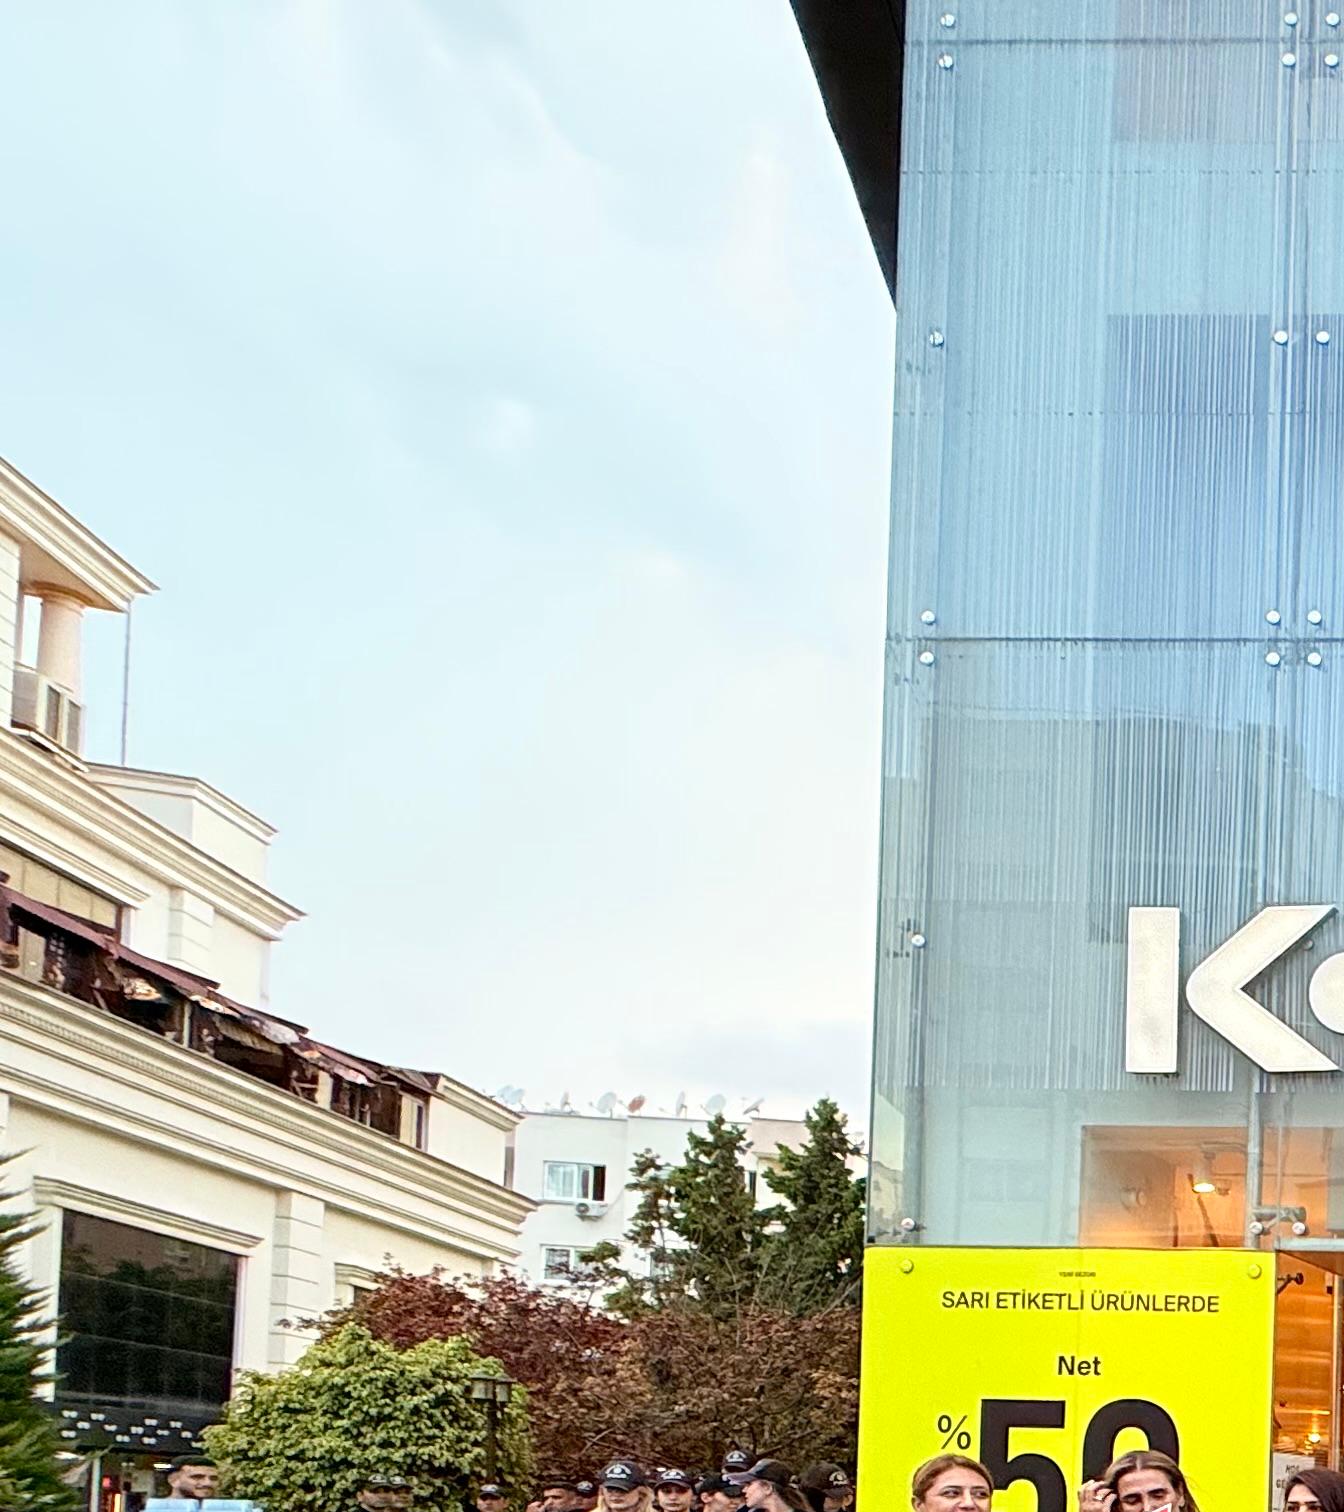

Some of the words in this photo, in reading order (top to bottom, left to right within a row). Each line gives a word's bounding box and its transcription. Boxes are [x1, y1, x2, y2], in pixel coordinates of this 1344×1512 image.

[942, 1291, 989, 1310] SARI
[996, 1289, 1084, 1311] ETİKETLİ
[1091, 1290, 1220, 1313] ÜRÜNLERDE
[1058, 1355, 1101, 1376] Net
